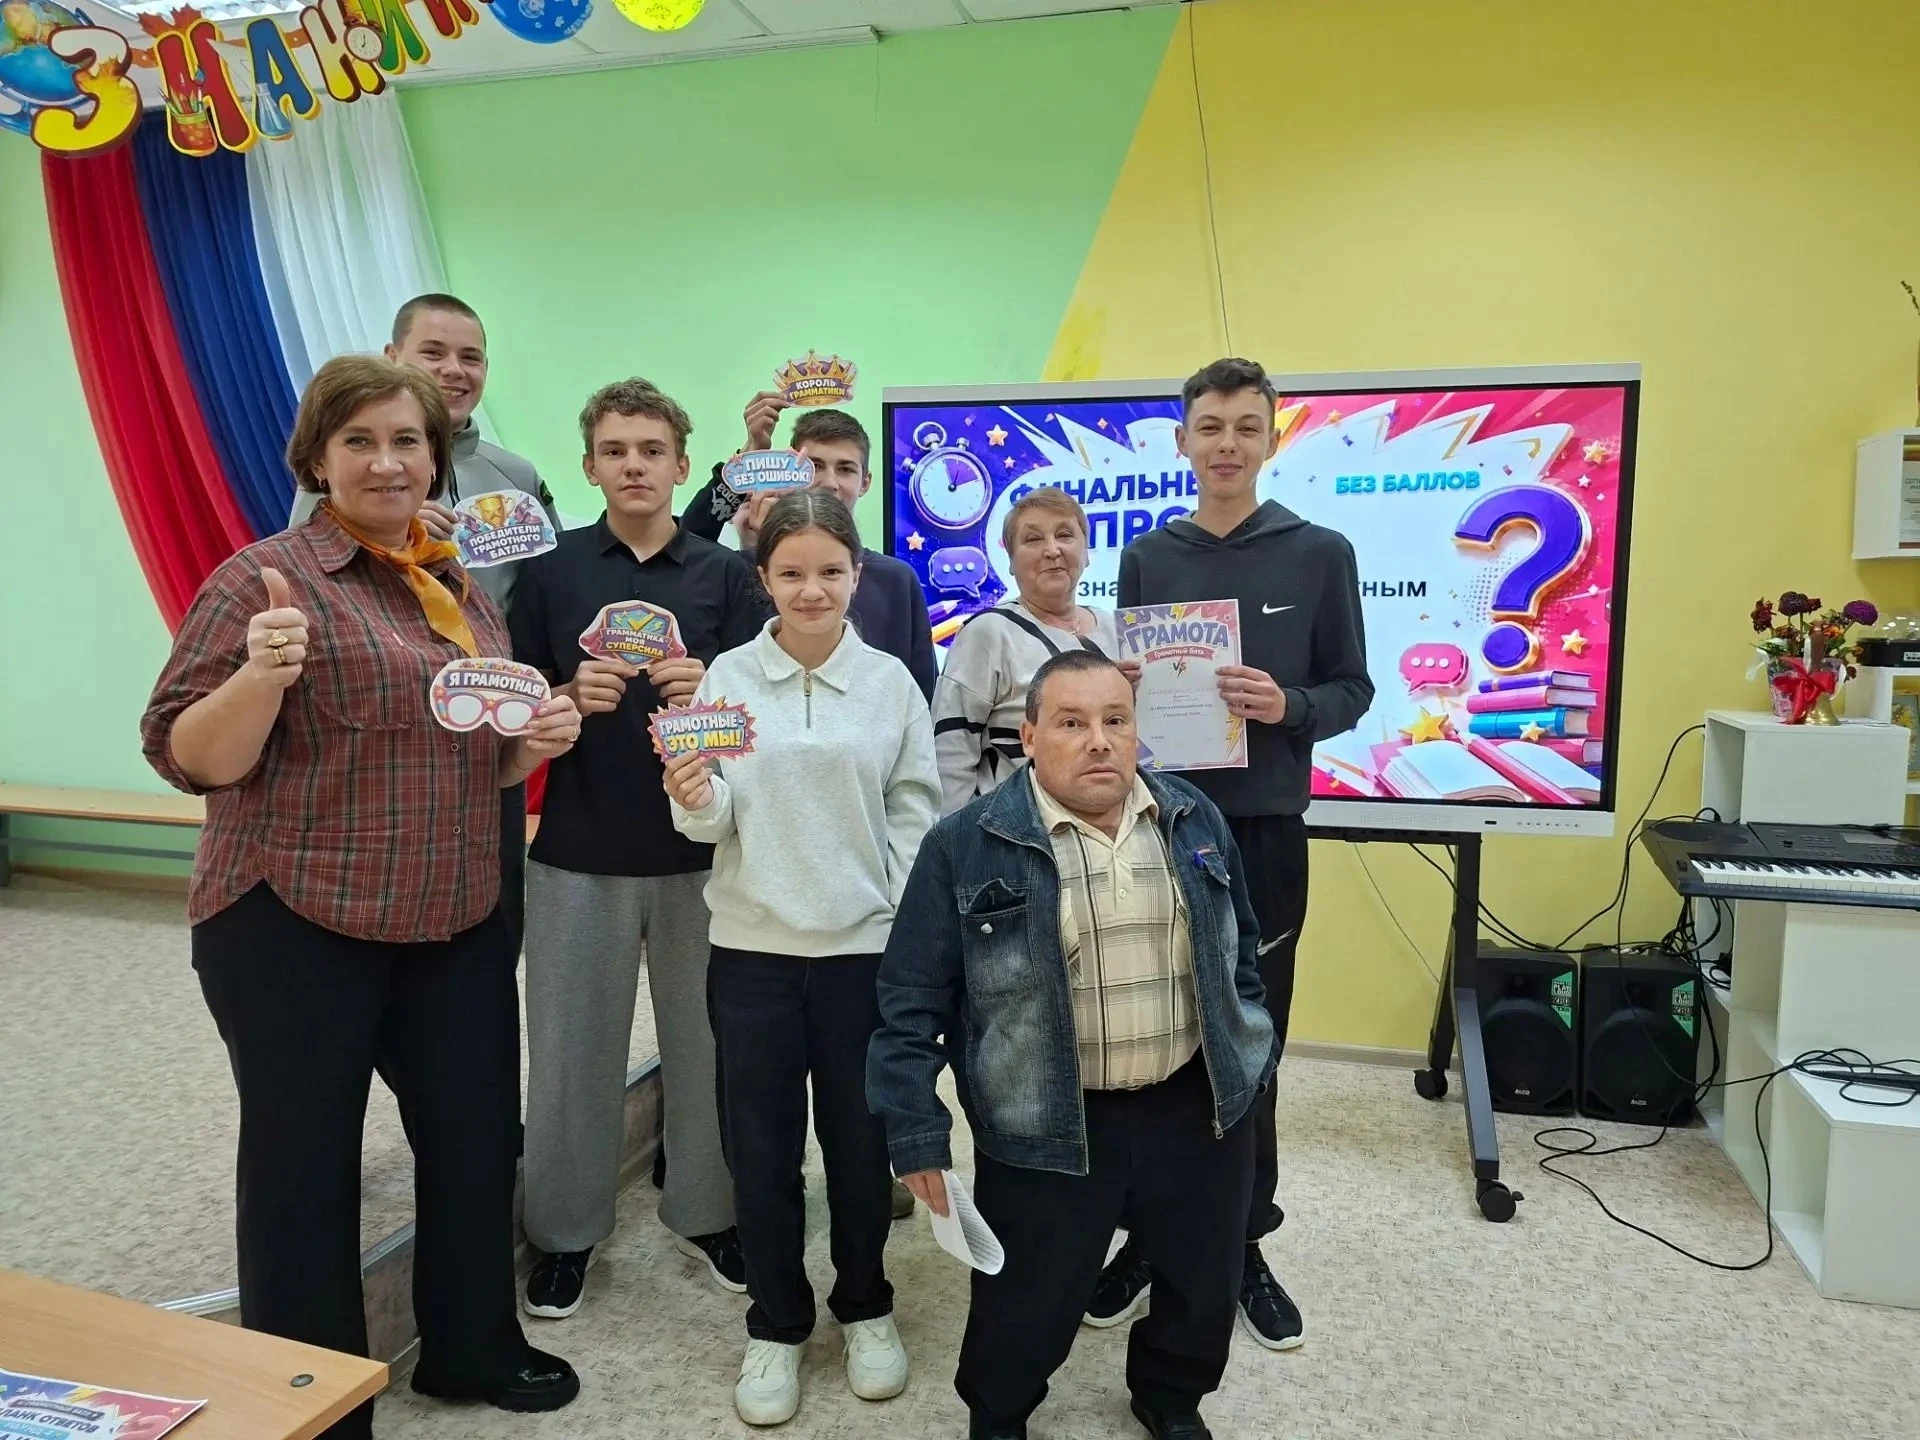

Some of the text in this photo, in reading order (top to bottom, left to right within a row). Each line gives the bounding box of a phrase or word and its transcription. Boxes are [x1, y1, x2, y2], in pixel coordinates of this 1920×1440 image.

[795, 379, 836, 390] КОРОЛЬ
[789, 387, 845, 400] ГРАММАТИКИ
[745, 457, 790, 471] ПИШУ
[734, 470, 809, 486] БЕЗ ОШИБОК!
[1335, 471, 1480, 494] БЕЗ БАЛЛОВ
[469, 525, 540, 547] ПОБЕДИТЕЛИ
[472, 534, 540, 556] ГРАМОТНОГО
[489, 543, 529, 559] БАТЛА
[1357, 581, 1427, 597] ным
[625, 637, 645, 645] МОЯ
[1125, 622, 1229, 653] ГРАМОТА
[605, 641, 664, 657] СУПЕРСИЛА
[449, 672, 544, 698] Я ГРАМОТНАЯ!
[667, 730, 741, 752] ЭТО МЫ!
[39, 1415, 100, 1433] ОТВЕТОВ
